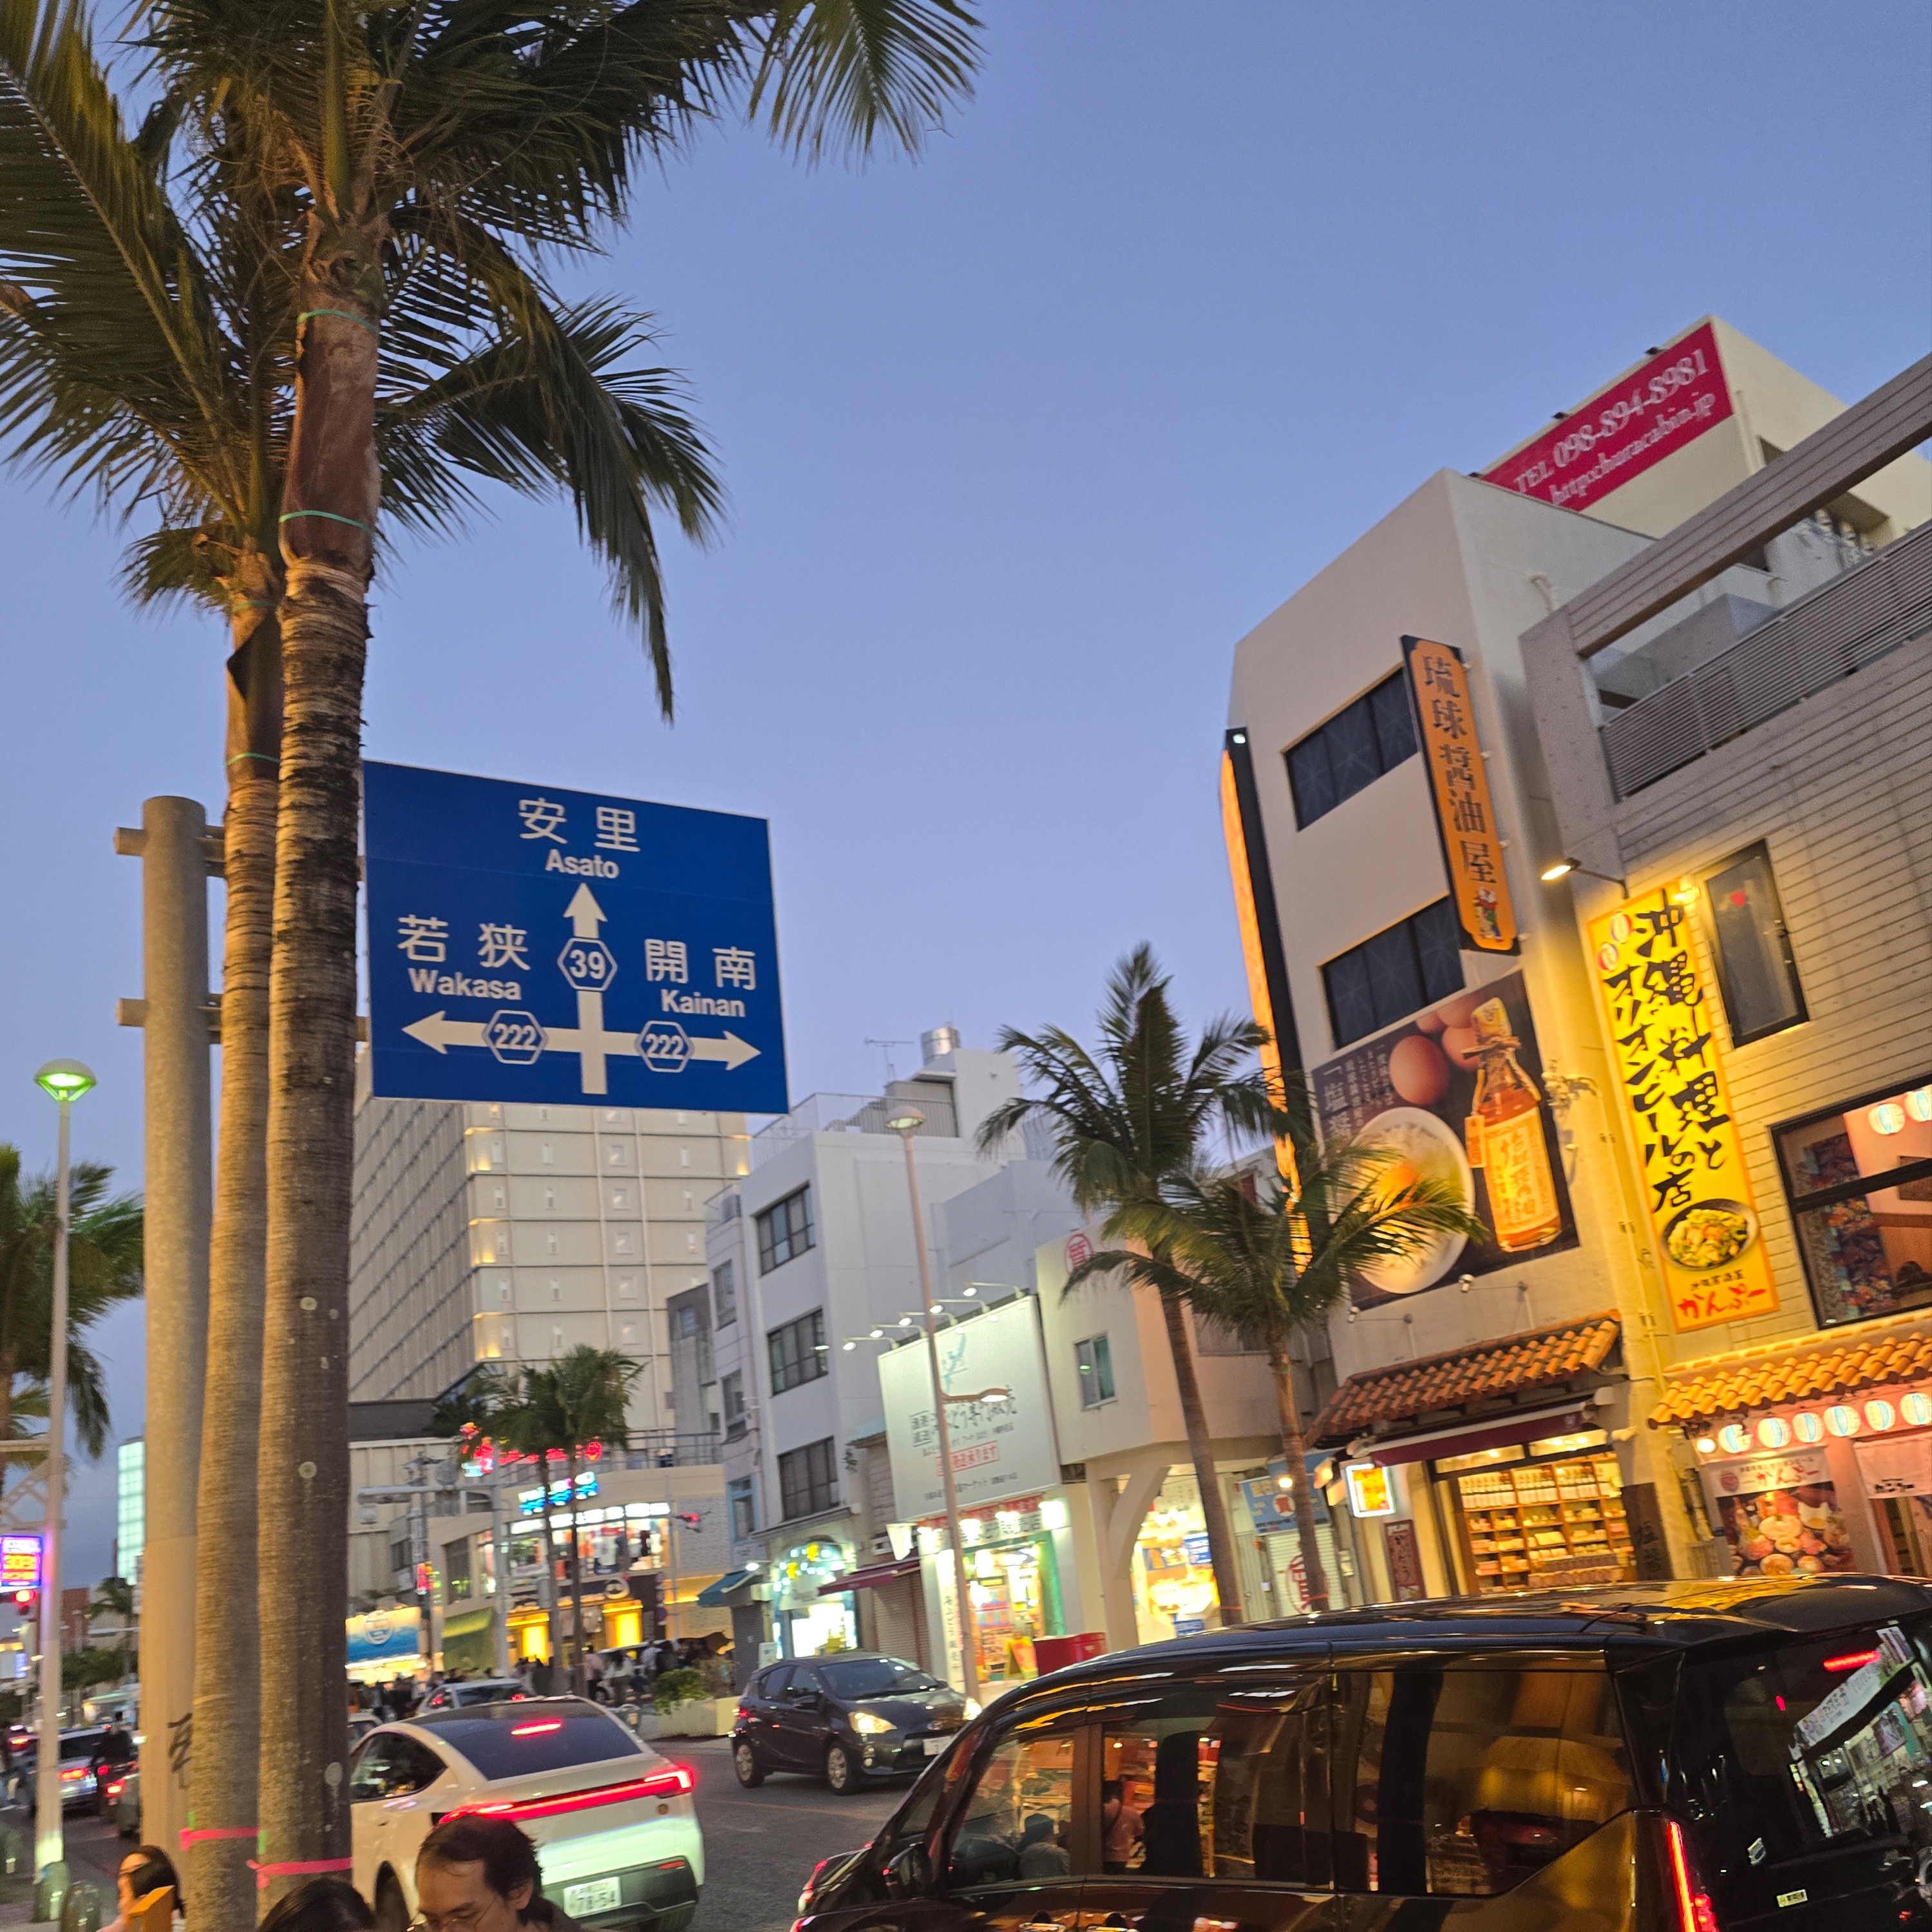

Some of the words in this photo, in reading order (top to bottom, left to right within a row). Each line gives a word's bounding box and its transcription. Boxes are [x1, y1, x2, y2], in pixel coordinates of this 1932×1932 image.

[1513, 461, 1555, 494] TEL
[518, 797, 641, 853] 安里
[545, 849, 620, 879] Asato
[397, 914, 531, 971] 若狭
[569, 949, 605, 980] 39
[645, 938, 757, 990] 開南
[408, 967, 522, 1001] Wakasa
[660, 989, 746, 1018] Kainan
[493, 1023, 537, 1050] 222
[645, 1034, 684, 1059] 222
